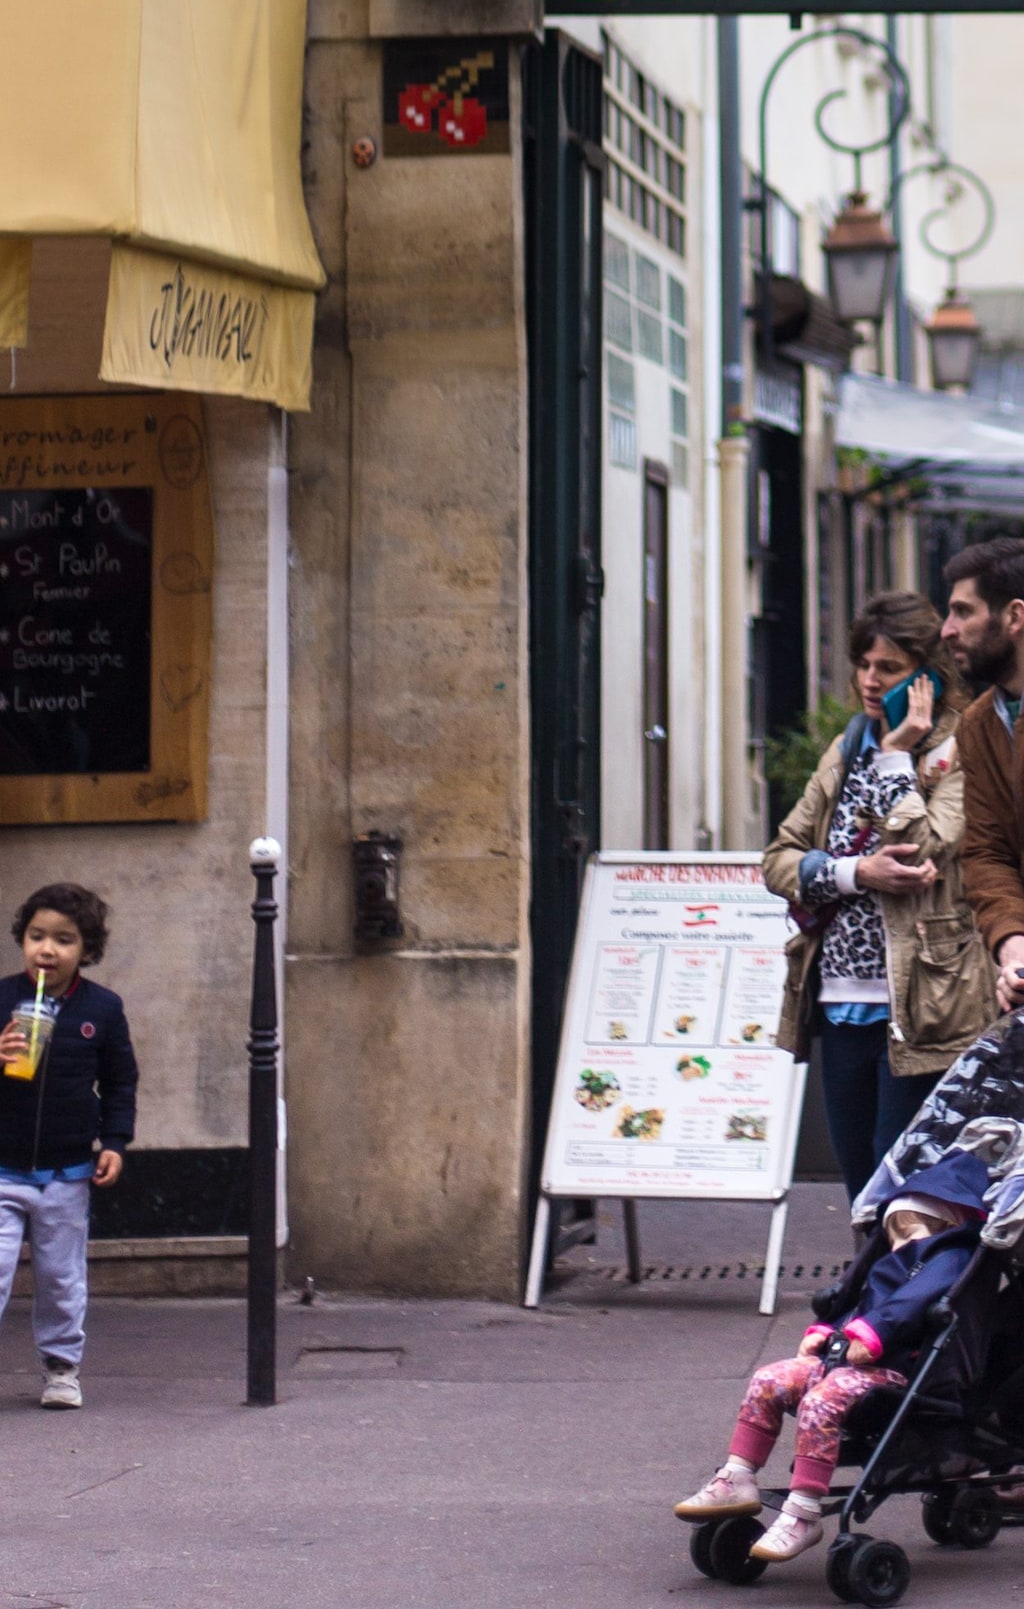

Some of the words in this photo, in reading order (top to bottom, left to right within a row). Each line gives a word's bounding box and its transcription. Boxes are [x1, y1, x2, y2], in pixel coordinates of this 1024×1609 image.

[11, 499, 65, 528] Mont
[14, 545, 43, 576] St
[59, 543, 121, 574] Paulin
[88, 621, 111, 644] de
[12, 649, 124, 675] Bourgogne
[14, 686, 96, 712] Livarot
